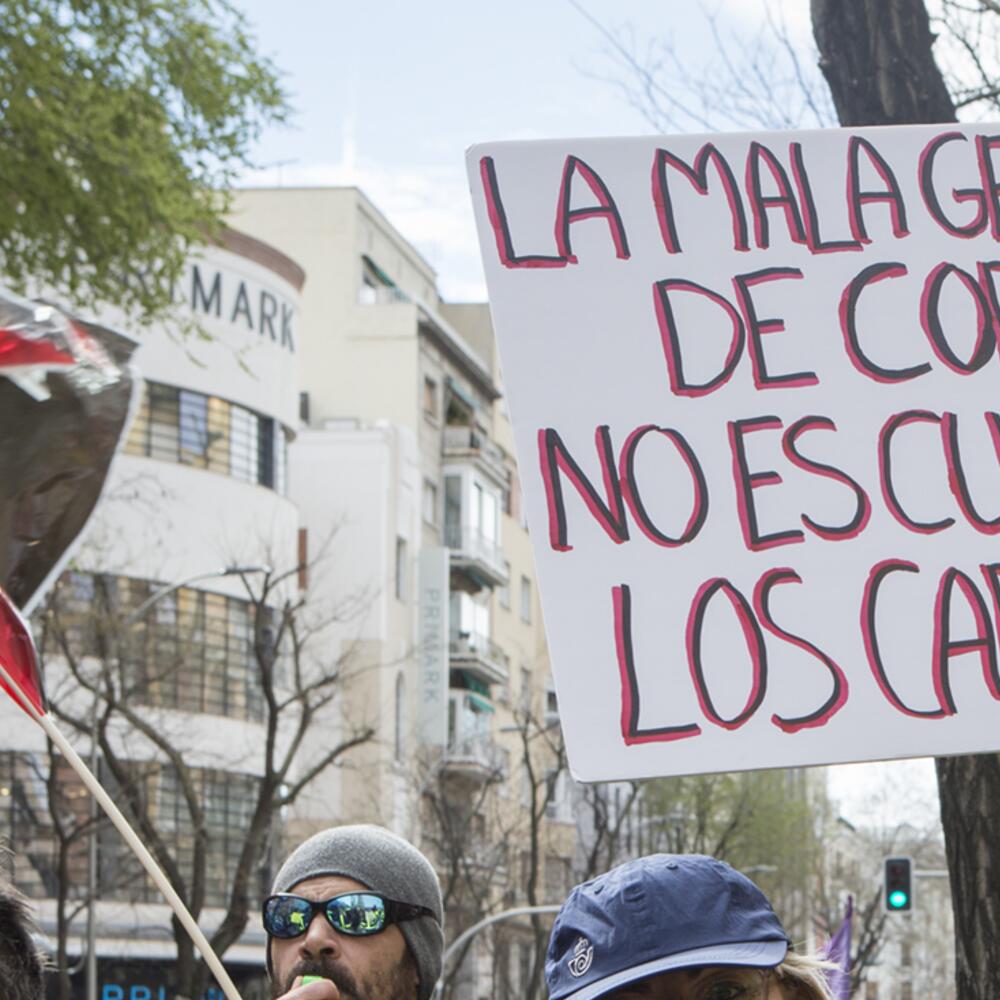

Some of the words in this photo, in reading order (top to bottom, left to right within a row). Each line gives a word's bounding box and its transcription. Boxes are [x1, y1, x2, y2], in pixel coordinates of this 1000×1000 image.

[480, 155, 631, 268] LA
[651, 135, 911, 254] MALA
[653, 267, 820, 398] DE
[537, 423, 709, 552] NO
[727, 415, 872, 552] ES
[611, 566, 849, 746] LOS
